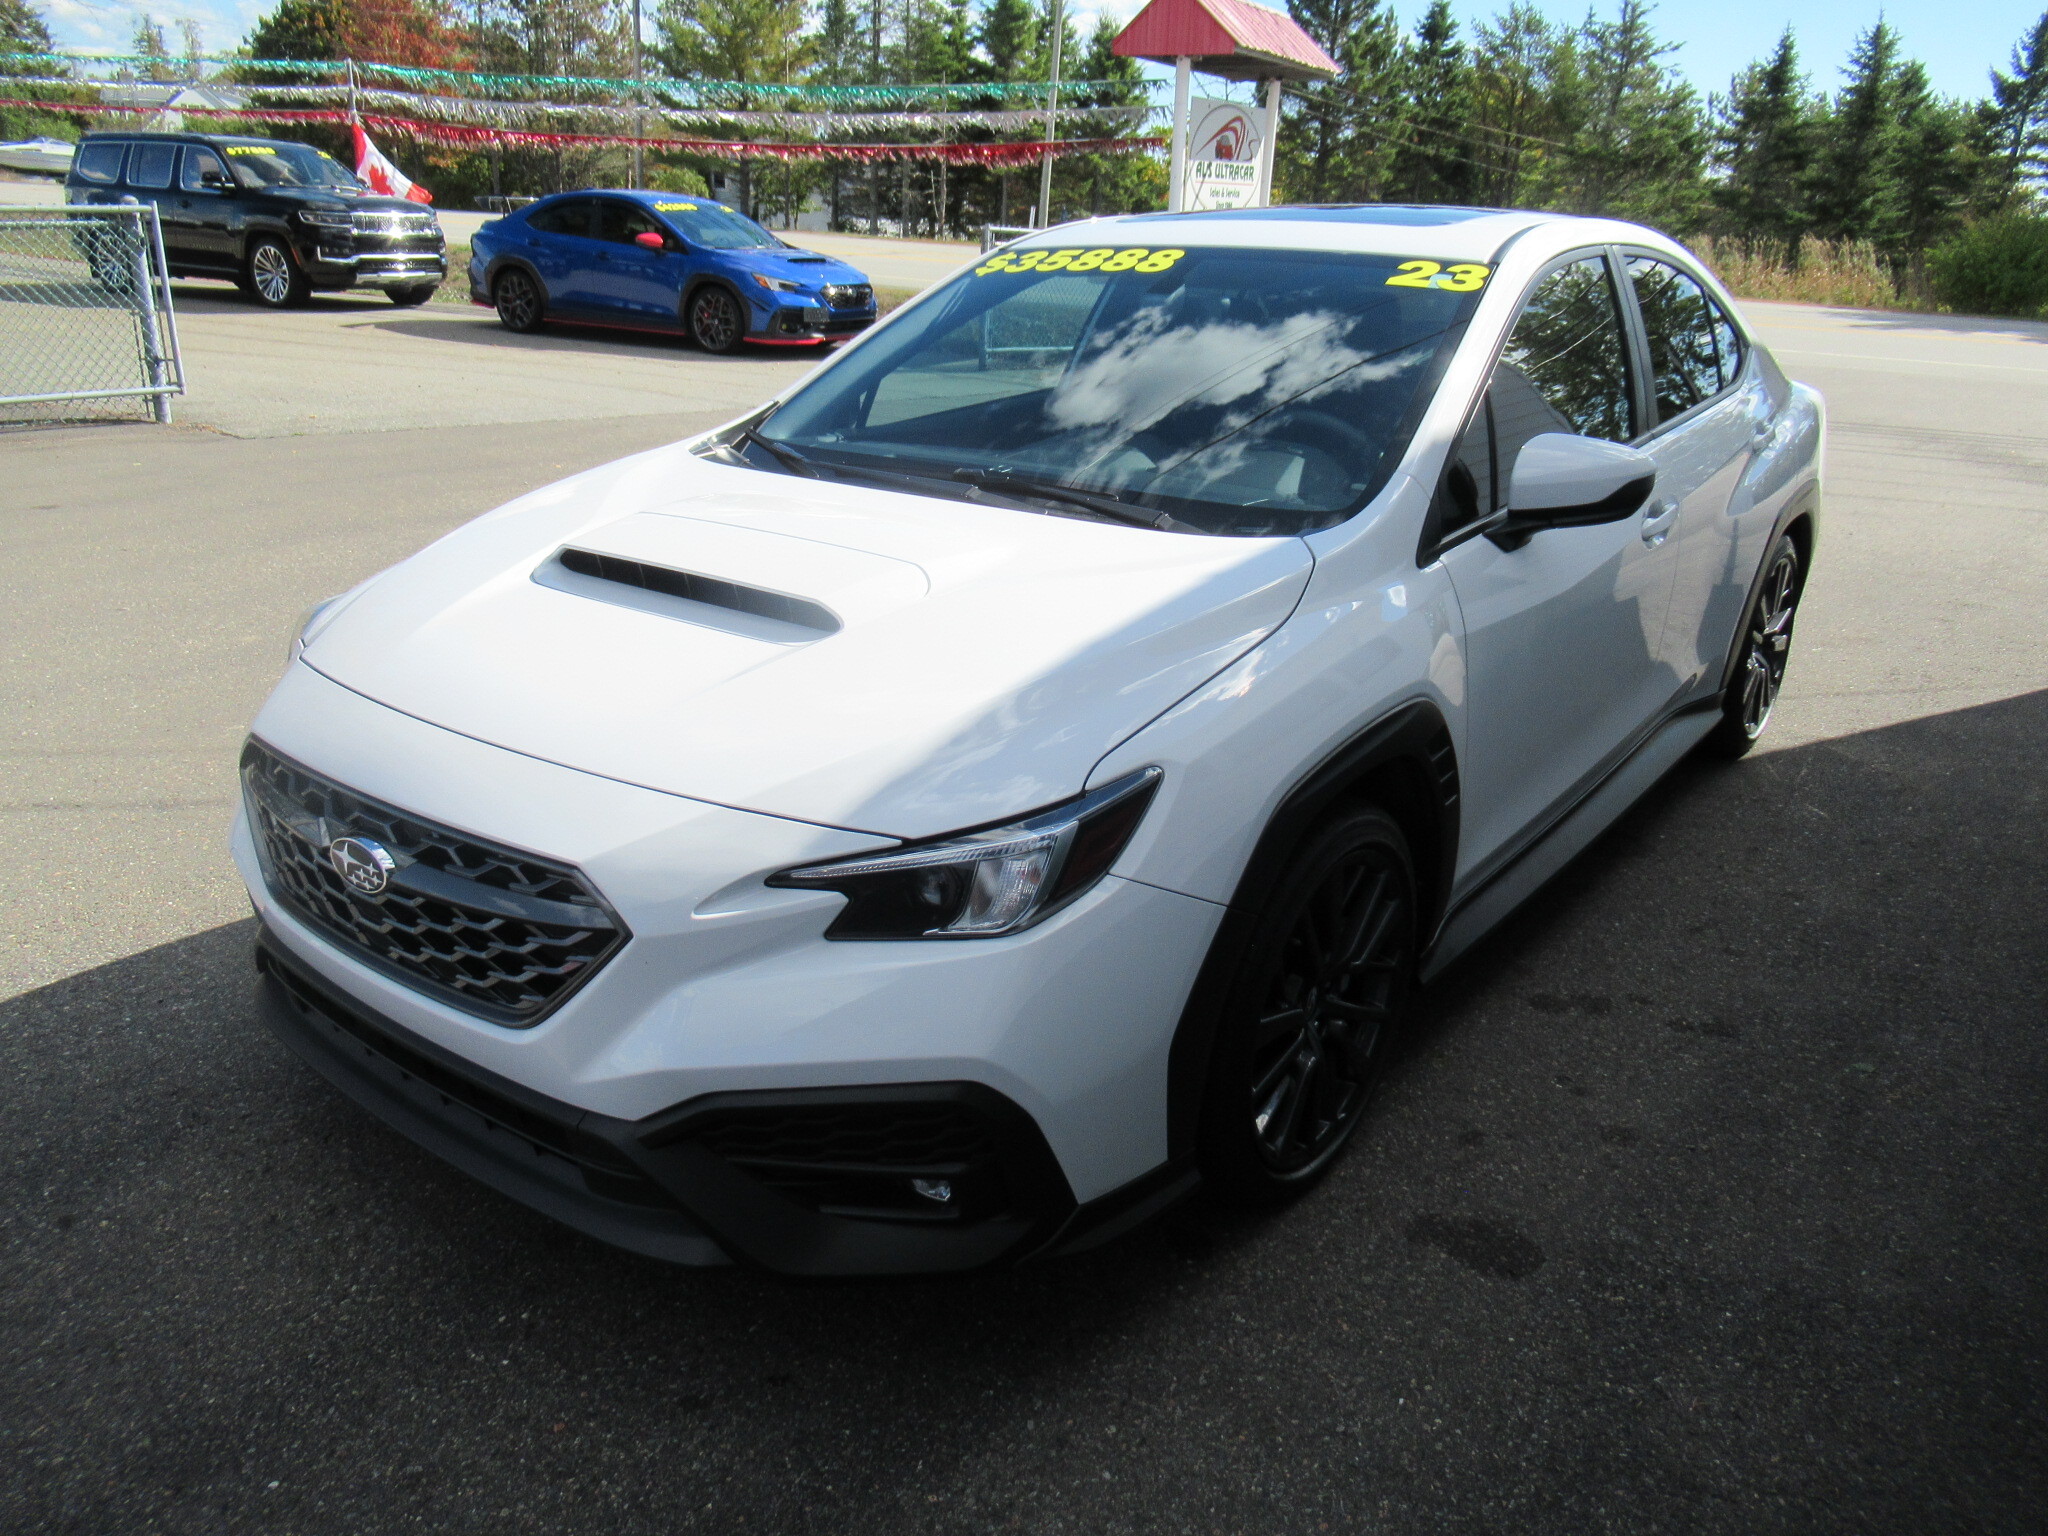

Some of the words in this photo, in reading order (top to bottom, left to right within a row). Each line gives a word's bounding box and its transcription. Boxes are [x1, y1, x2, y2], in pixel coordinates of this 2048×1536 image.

[1215, 163, 1255, 182] ULTRACAR
[975, 248, 1186, 277] $35888
[1384, 260, 1491, 292] 23
